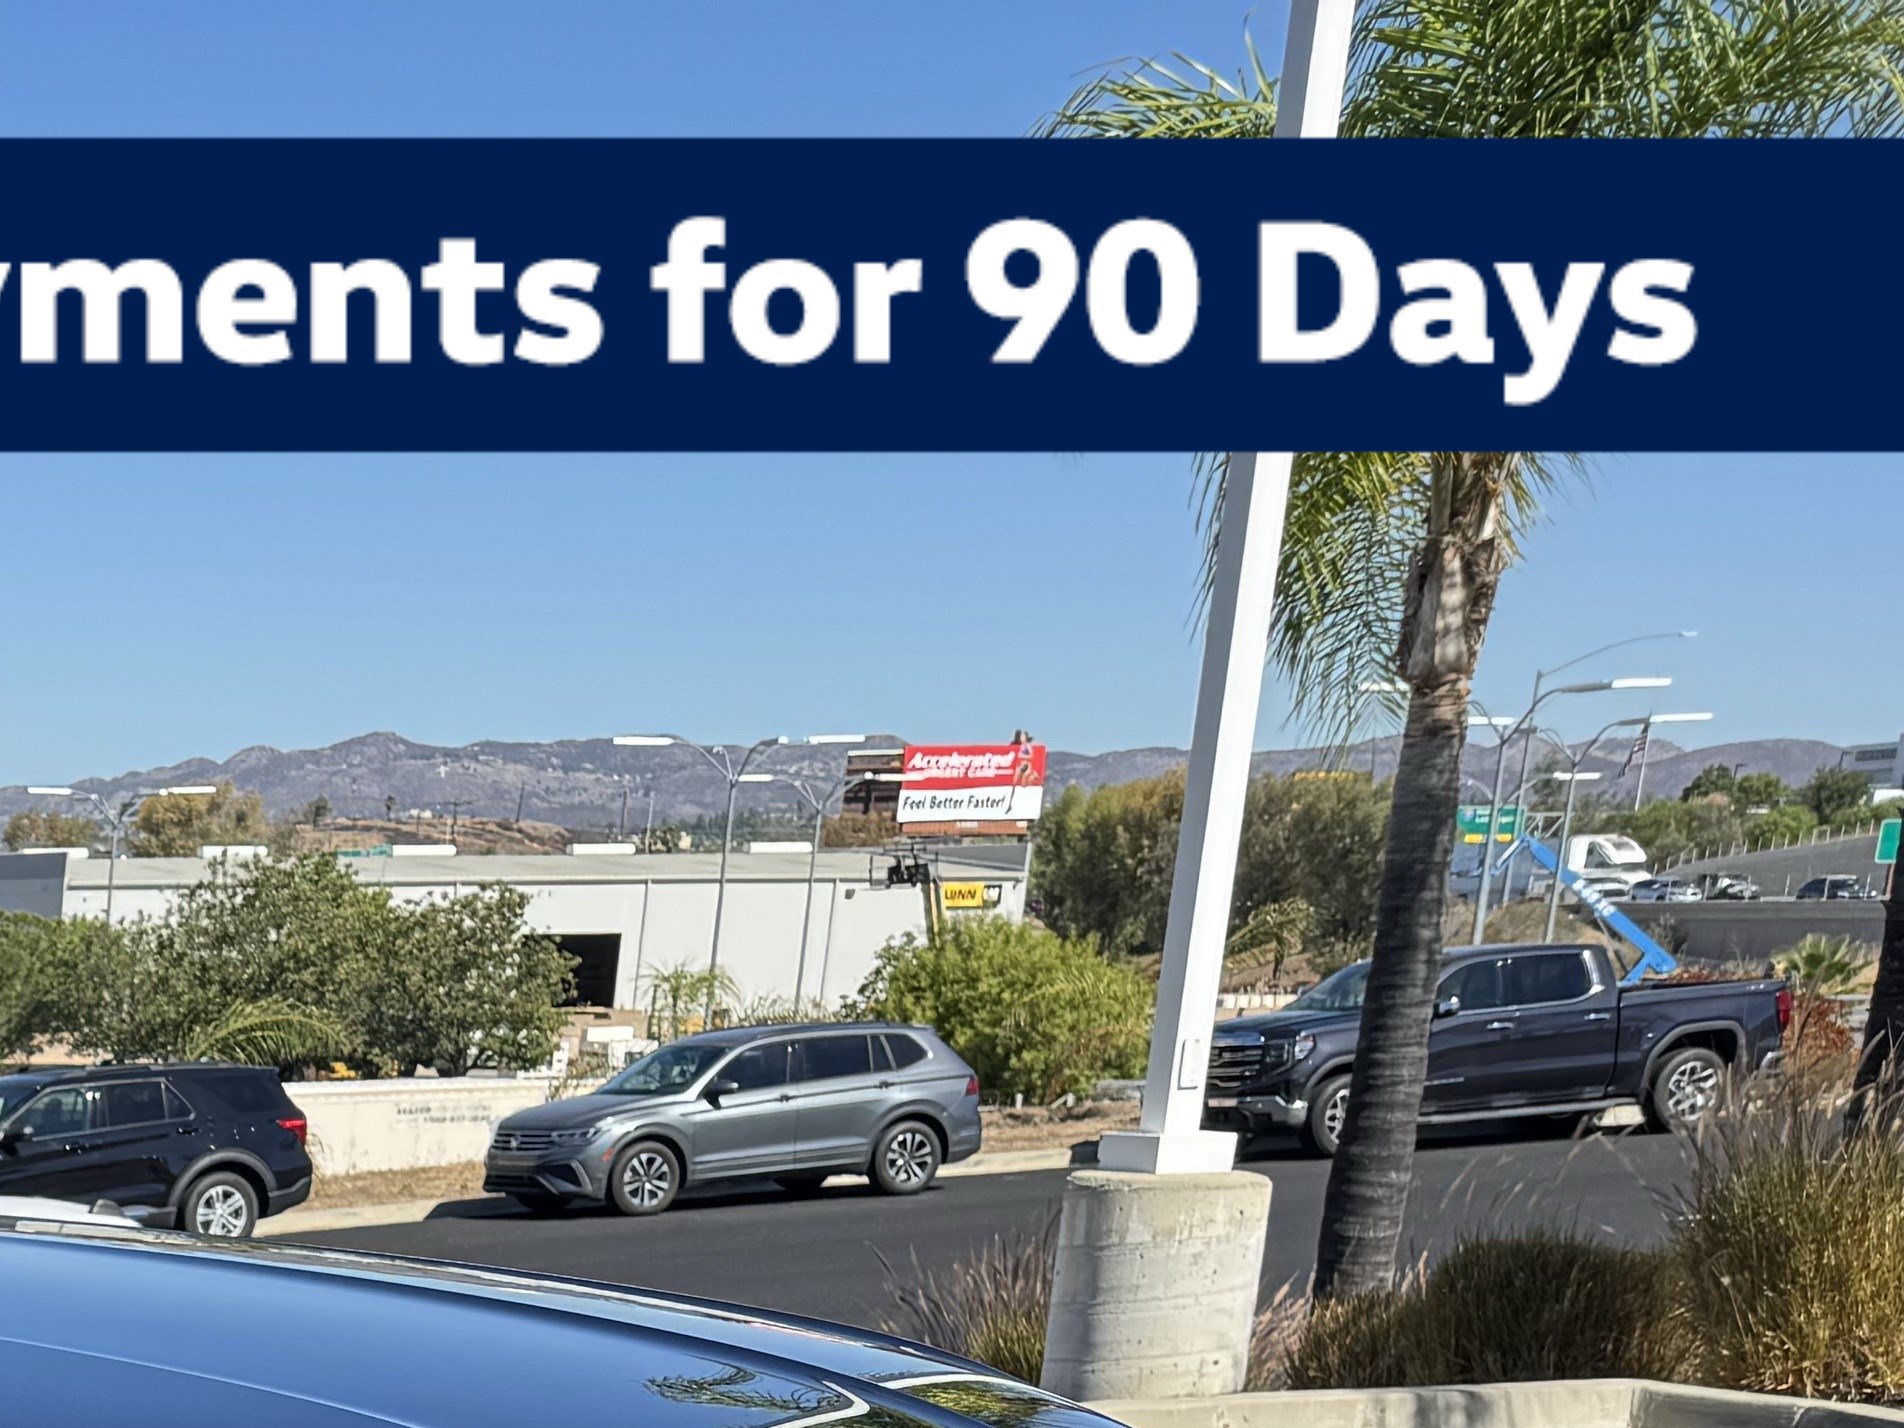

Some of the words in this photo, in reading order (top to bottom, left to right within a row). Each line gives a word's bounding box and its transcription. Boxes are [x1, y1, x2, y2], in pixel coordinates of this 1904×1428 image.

[907, 751, 1016, 769] Accelerated
[903, 796, 926, 811] Feel
[930, 795, 964, 810] Better
[967, 794, 1005, 809] Faster!
